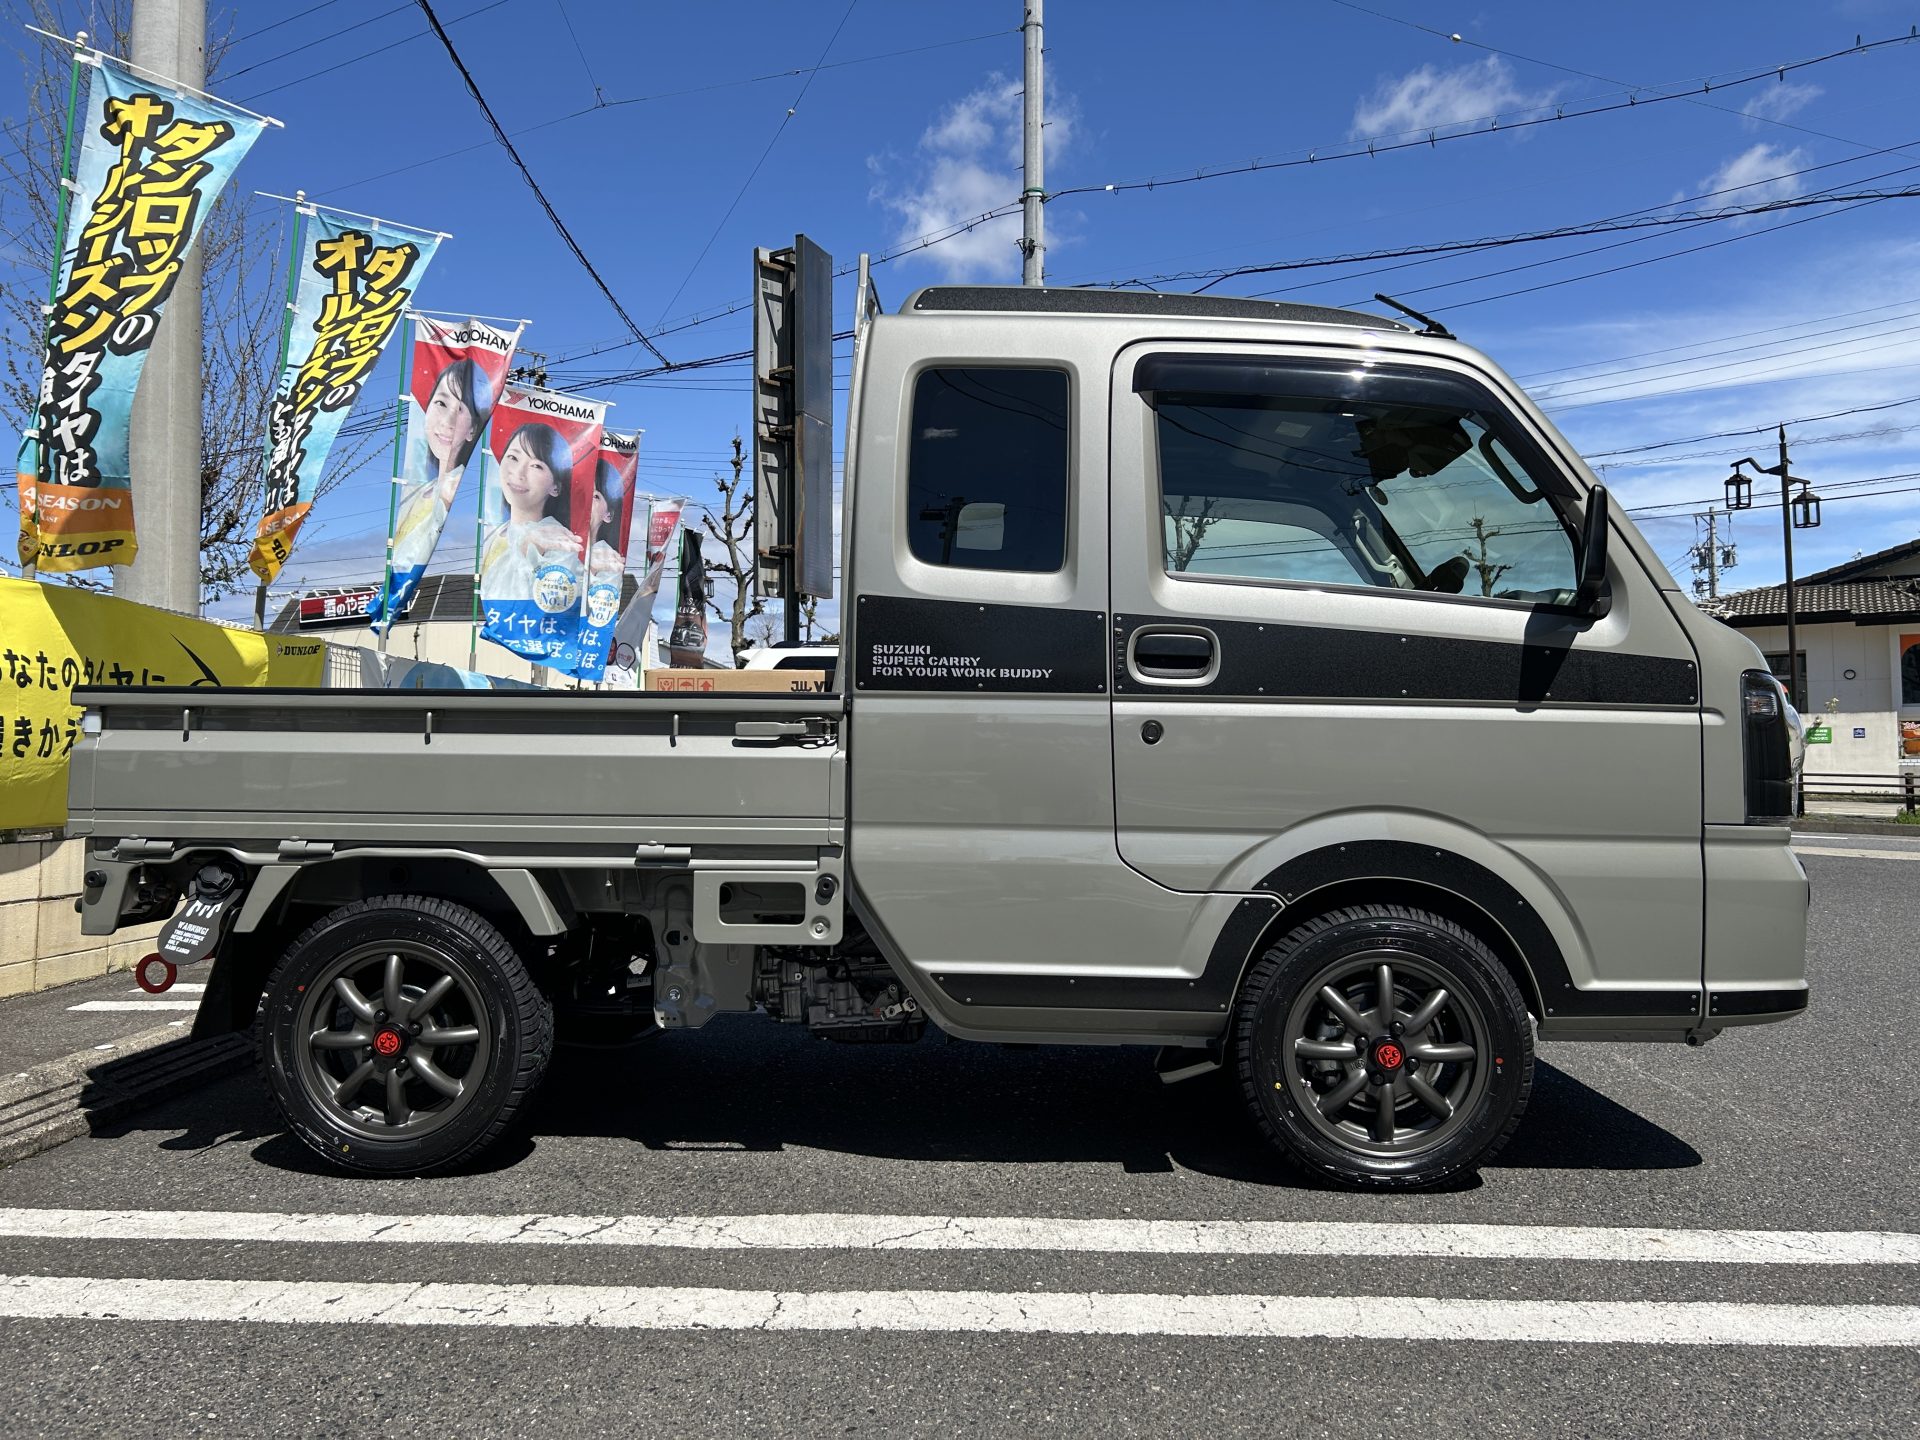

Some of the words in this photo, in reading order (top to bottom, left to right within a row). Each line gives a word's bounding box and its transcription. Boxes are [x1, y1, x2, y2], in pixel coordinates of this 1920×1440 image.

[113, 121, 226, 346] ダンロップの
[324, 245, 412, 405] ダンロップの
[527, 396, 595, 420] YOKOHAMA
[38, 493, 122, 511] SEASON
[323, 594, 375, 618] 酒のやま
[487, 607, 567, 636] タイヤは、
[284, 645, 321, 656] DUNLOP
[872, 644, 931, 655] SUZUKI
[872, 655, 924, 666] SUPER
[928, 656, 981, 667] CARRY
[872, 666, 903, 677] FOR
[906, 667, 948, 678] YOUR
[951, 667, 997, 678] WORK
[999, 668, 1053, 679] BUDDY
